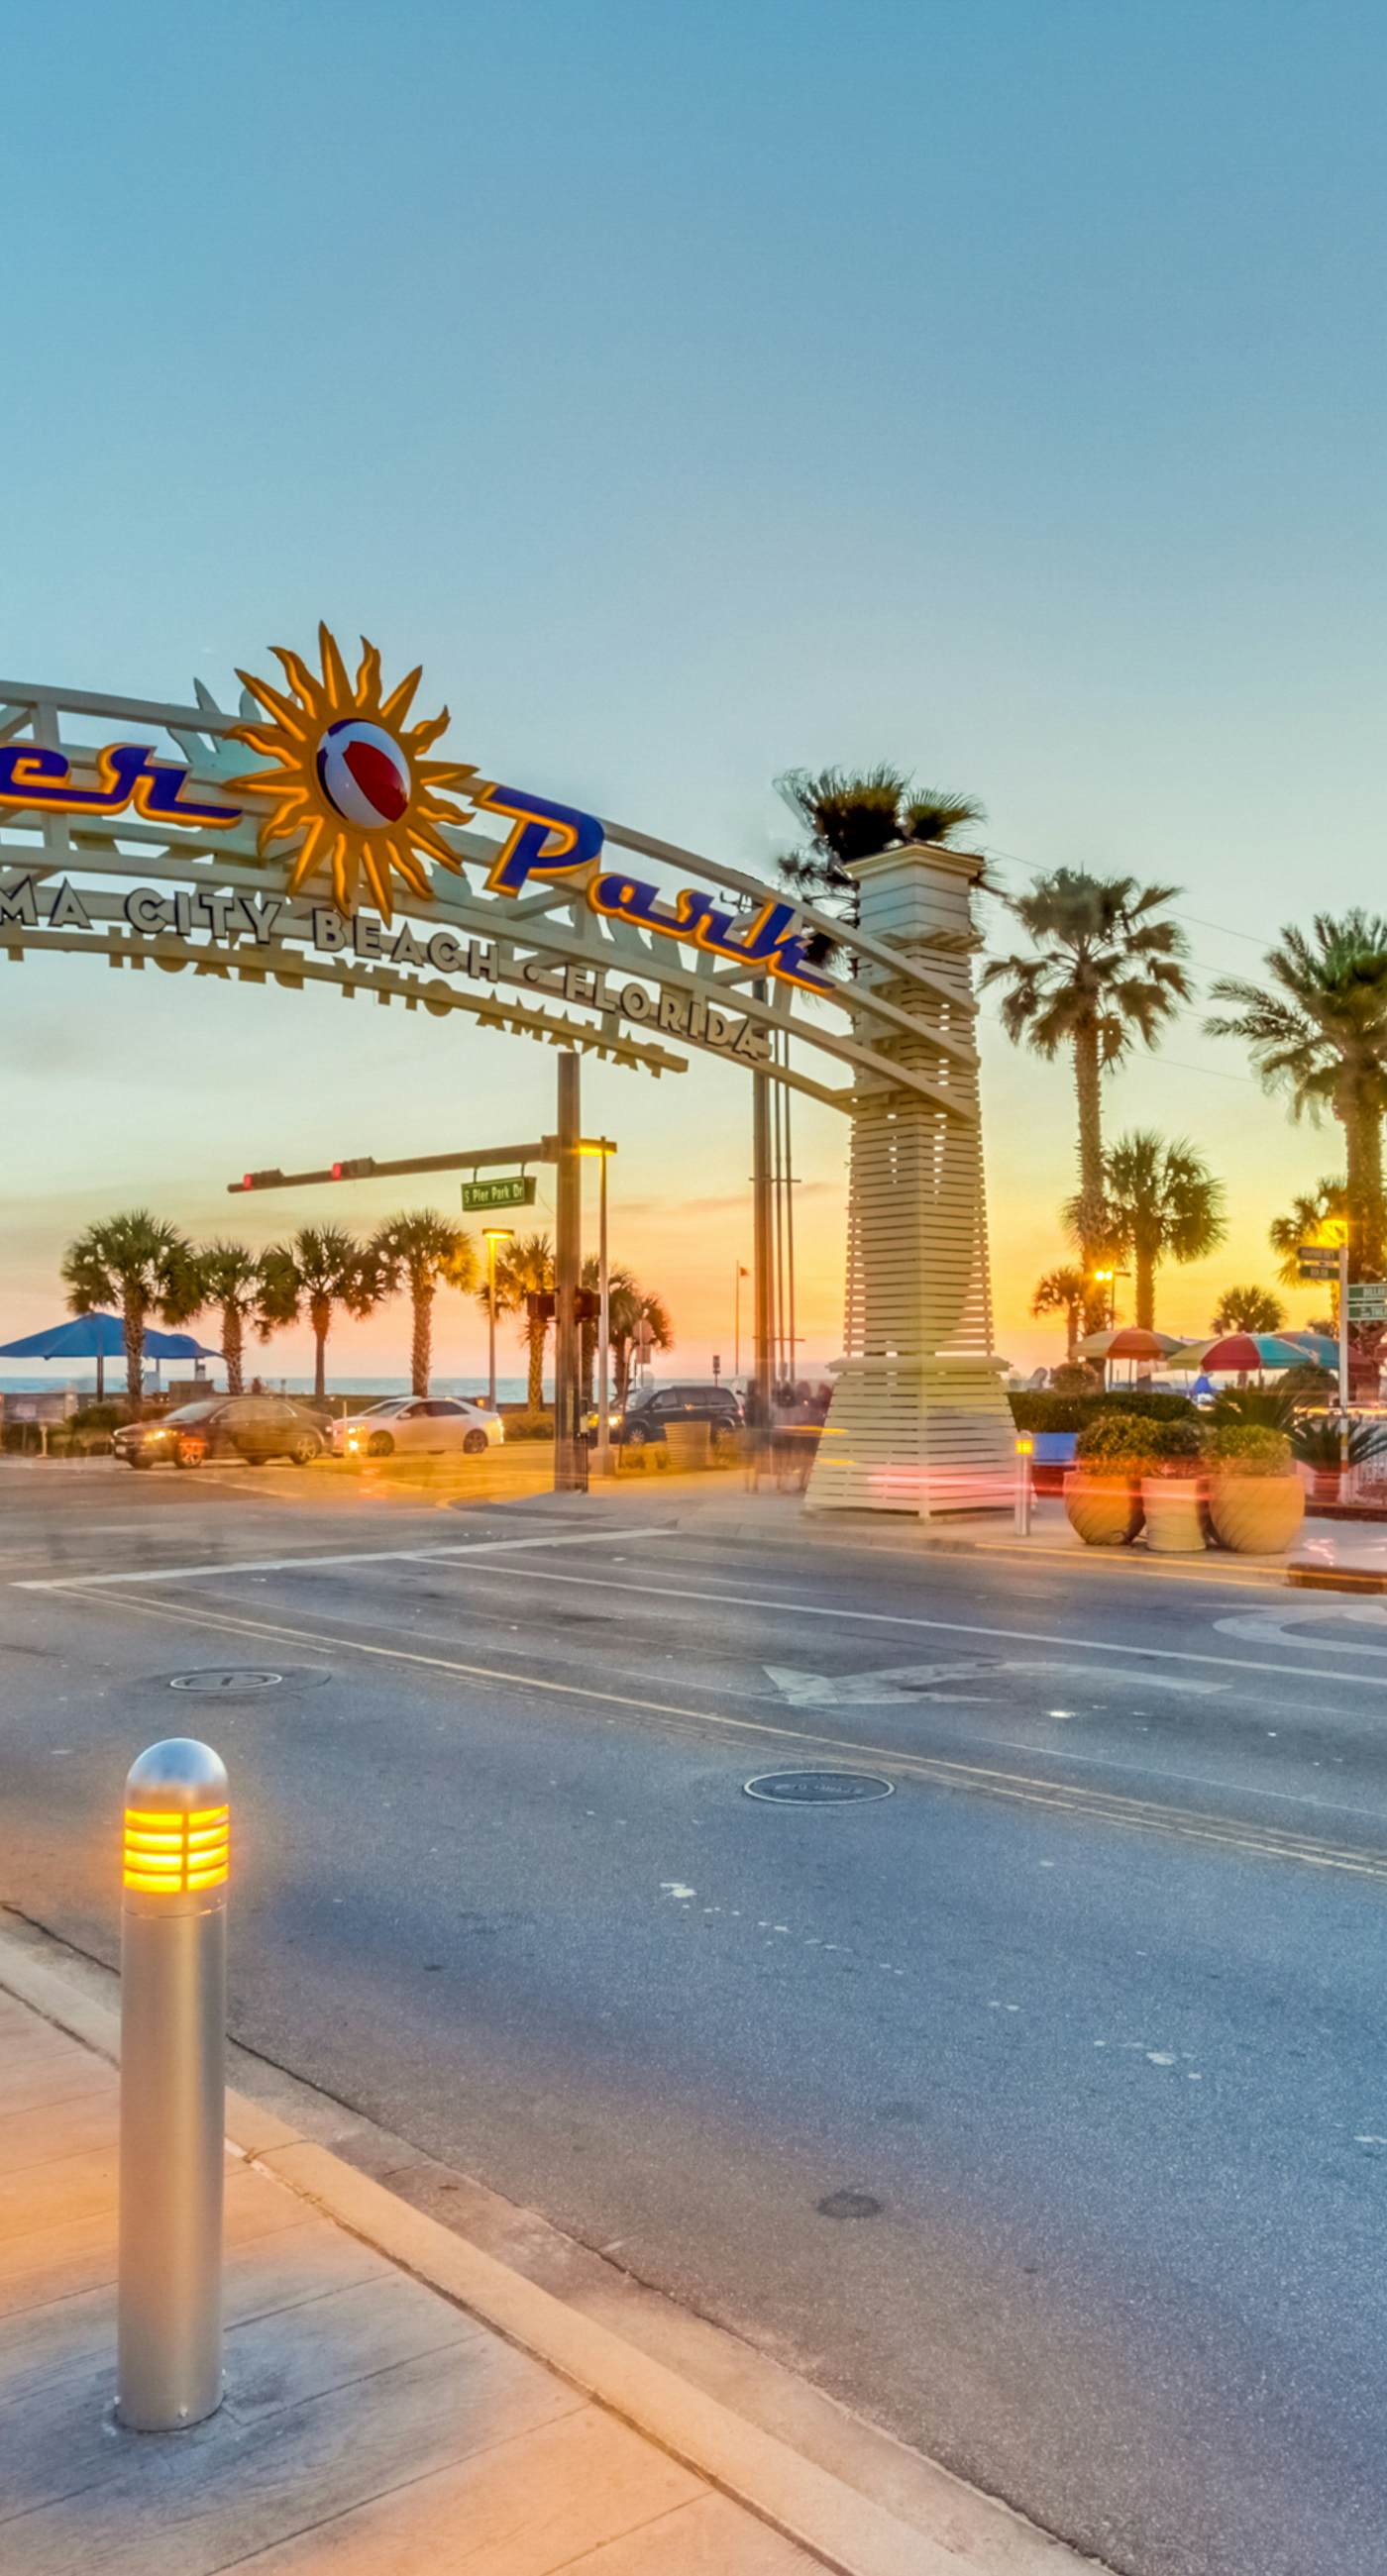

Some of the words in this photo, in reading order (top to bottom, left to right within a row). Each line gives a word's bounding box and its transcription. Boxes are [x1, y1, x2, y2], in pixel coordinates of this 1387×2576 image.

[124, 887, 282, 945] CITY
[312, 907, 501, 983] BEACH
[565, 963, 769, 1061] FLORIDA
[469, 781, 837, 995] Park
[464, 1189, 471, 1204] S
[473, 1187, 489, 1202] Pier
[491, 1185, 510, 1201] Park
[512, 1183, 523, 1198] Dr
